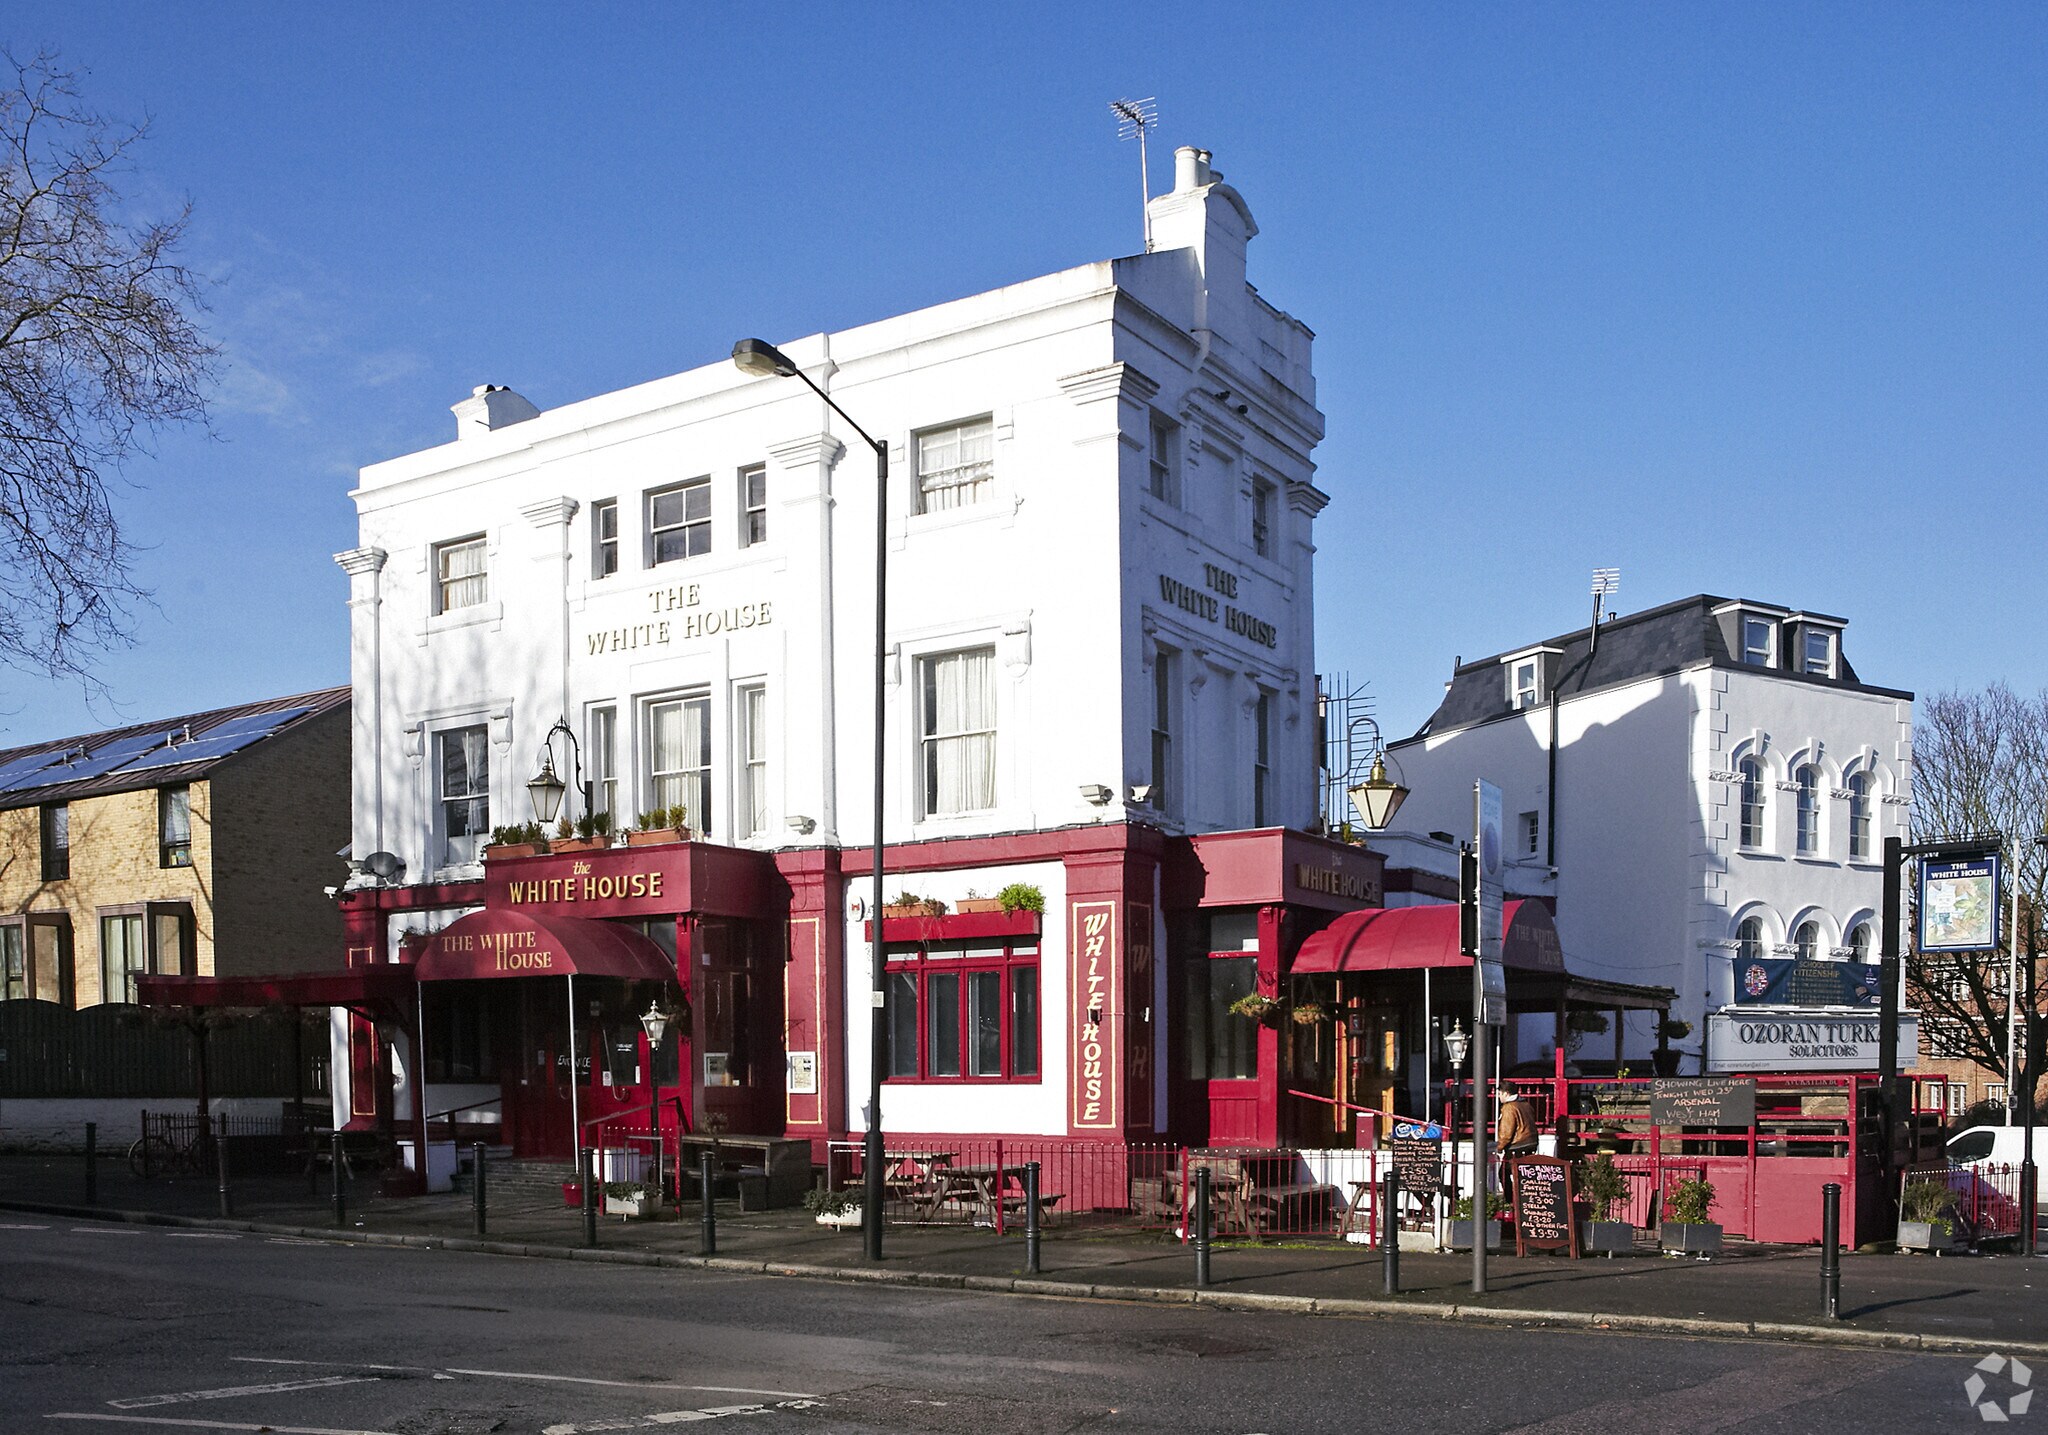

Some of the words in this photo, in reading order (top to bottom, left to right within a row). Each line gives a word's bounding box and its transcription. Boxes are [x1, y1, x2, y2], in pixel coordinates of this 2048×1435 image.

[1203, 562, 1238, 599] THE
[649, 583, 701, 614] THE
[1159, 574, 1219, 623] WHITE
[1225, 605, 1277, 649] HOUSE
[588, 621, 671, 656] WHITE
[684, 601, 772, 639] HOUSE
[573, 861, 592, 875] the
[1951, 862, 1968, 870] THE
[1930, 871, 1959, 879] WHITE
[1960, 868, 1989, 877] HOUSE
[509, 877, 578, 904] WHITE
[583, 871, 663, 901] HOUSE
[1299, 863, 1339, 895] WHITE
[1341, 873, 1378, 903] HOUSE
[1514, 923, 1530, 941] THE
[441, 935, 474, 952] THE
[480, 931, 537, 955] WHITE
[495, 940, 552, 970] HOUSE
[1083, 913, 1109, 1009] WHITE
[1799, 960, 1825, 968] SCHOOL
[1793, 968, 1840, 978] CITIZENSHIP
[1740, 1023, 1821, 1044] OZORAN
[1824, 1023, 1901, 1044] TURK
[1789, 1044, 1859, 1058] SOLICITORS
[1081, 1023, 1103, 1120] HOUSE
[1654, 1079, 1702, 1091] SHOWING
[1707, 1079, 1727, 1087] LIVE
[1728, 1078, 1751, 1086] HERE
[1653, 1090, 1688, 1100] TONIGHT
[1673, 1097, 1721, 1106] ARSENAL
[1666, 1110, 1694, 1118] WEST
[1699, 1109, 1720, 1118] HAM
[1680, 1117, 1718, 1126] SCREEN
[1518, 1165, 1536, 1178] The
[1535, 1165, 1563, 1175] White
[1536, 1172, 1565, 1182] House
[1426, 1174, 1442, 1183] BAR
[1520, 1179, 1552, 1187] CARLING
[1523, 1184, 1552, 1192] FOSTERS
[1522, 1202, 1547, 1210] STELLA
[1523, 1208, 1556, 1219] GUINNESS
